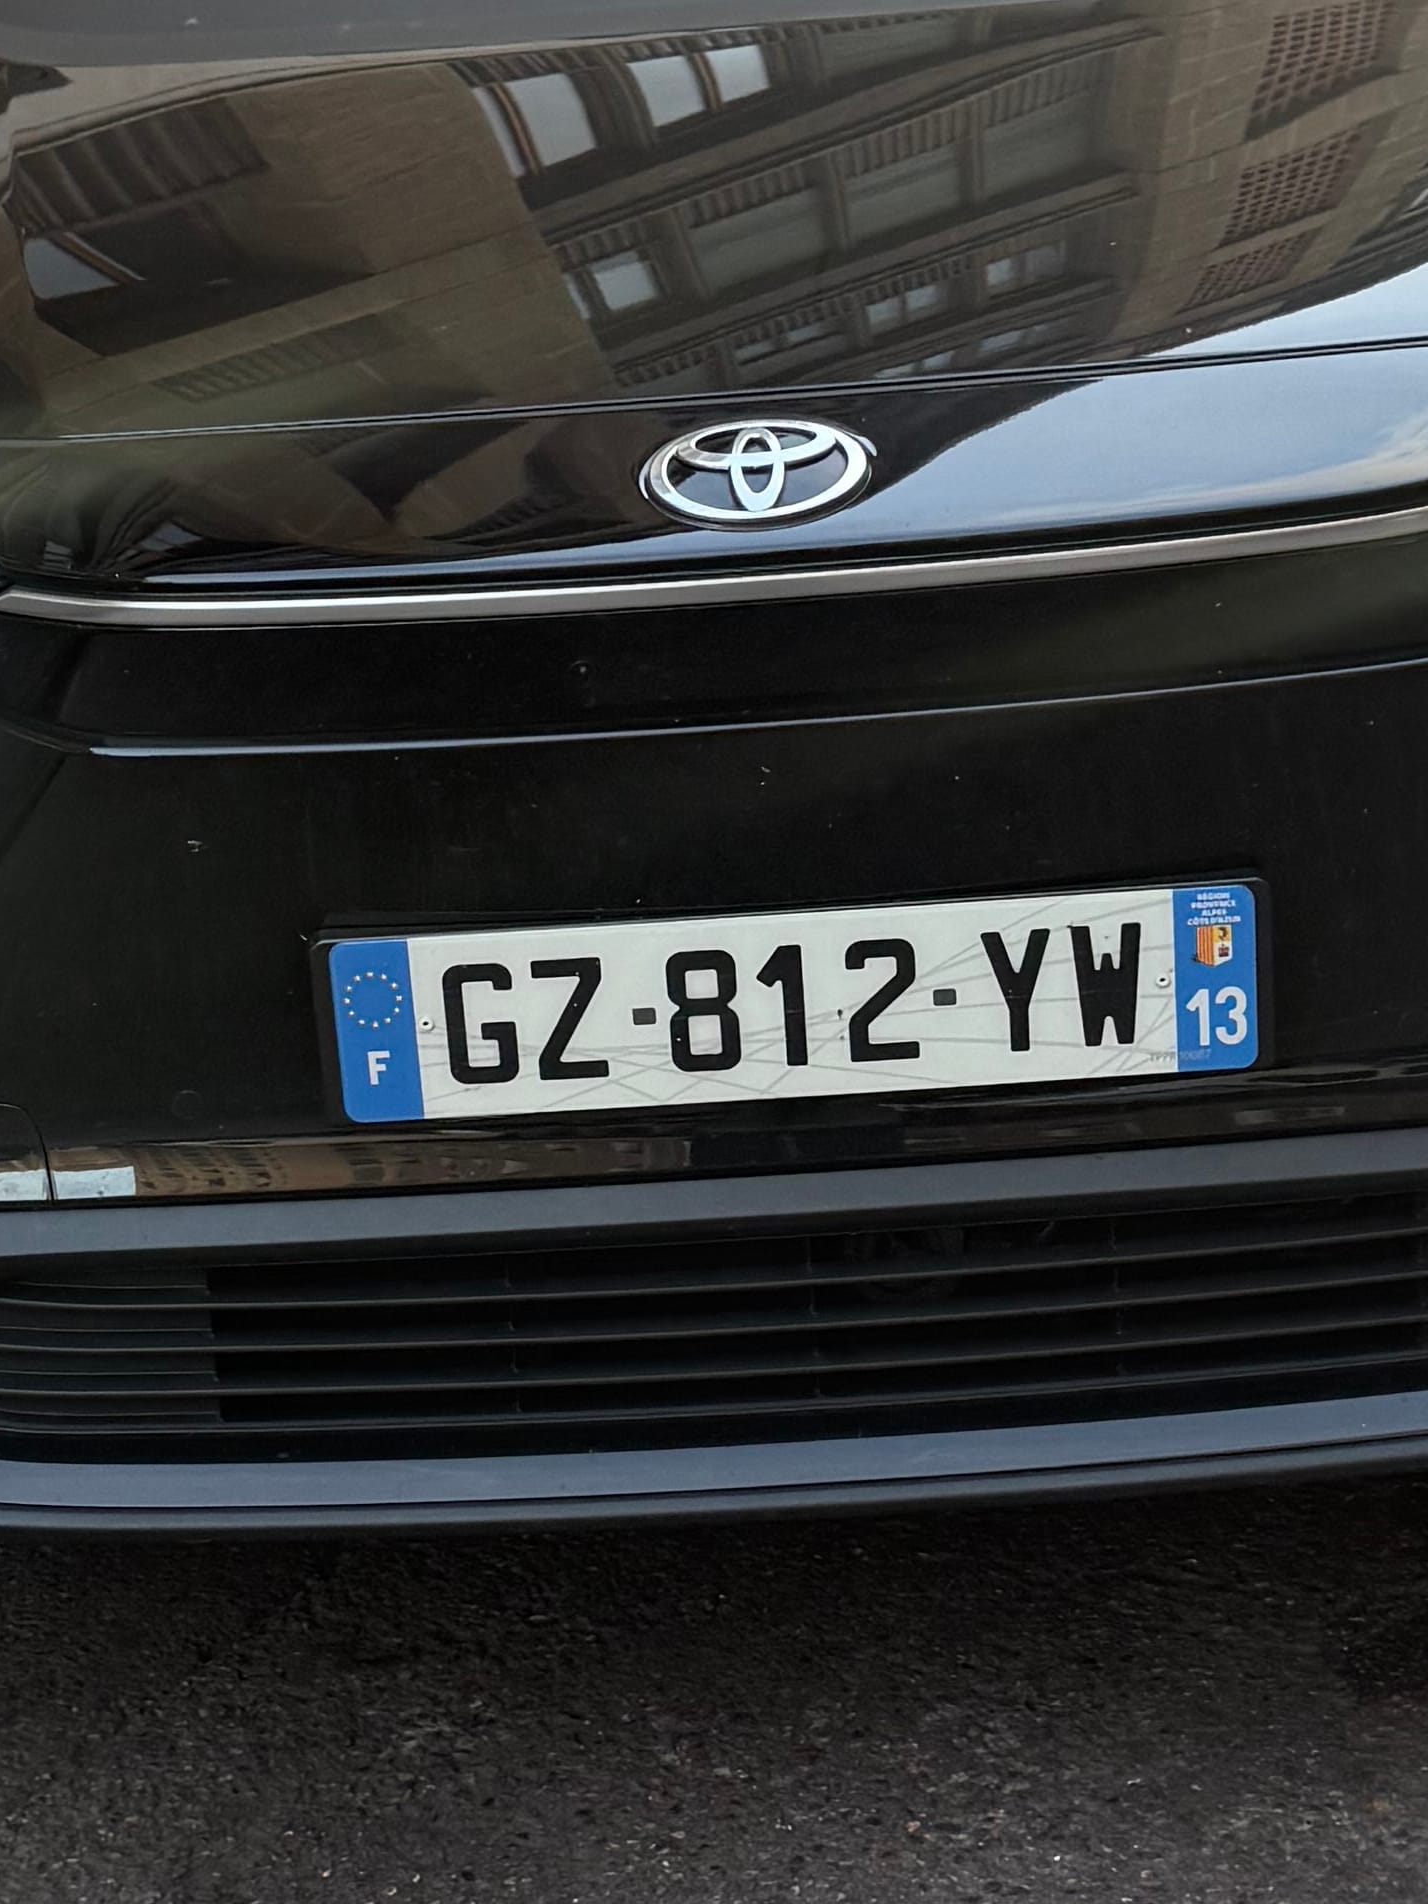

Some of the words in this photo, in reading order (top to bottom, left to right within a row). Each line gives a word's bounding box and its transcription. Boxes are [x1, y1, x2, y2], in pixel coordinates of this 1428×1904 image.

[441, 922, 1142, 1085] GZ-812-YW
[1185, 986, 1249, 1047] 13
[367, 1050, 391, 1087] F
